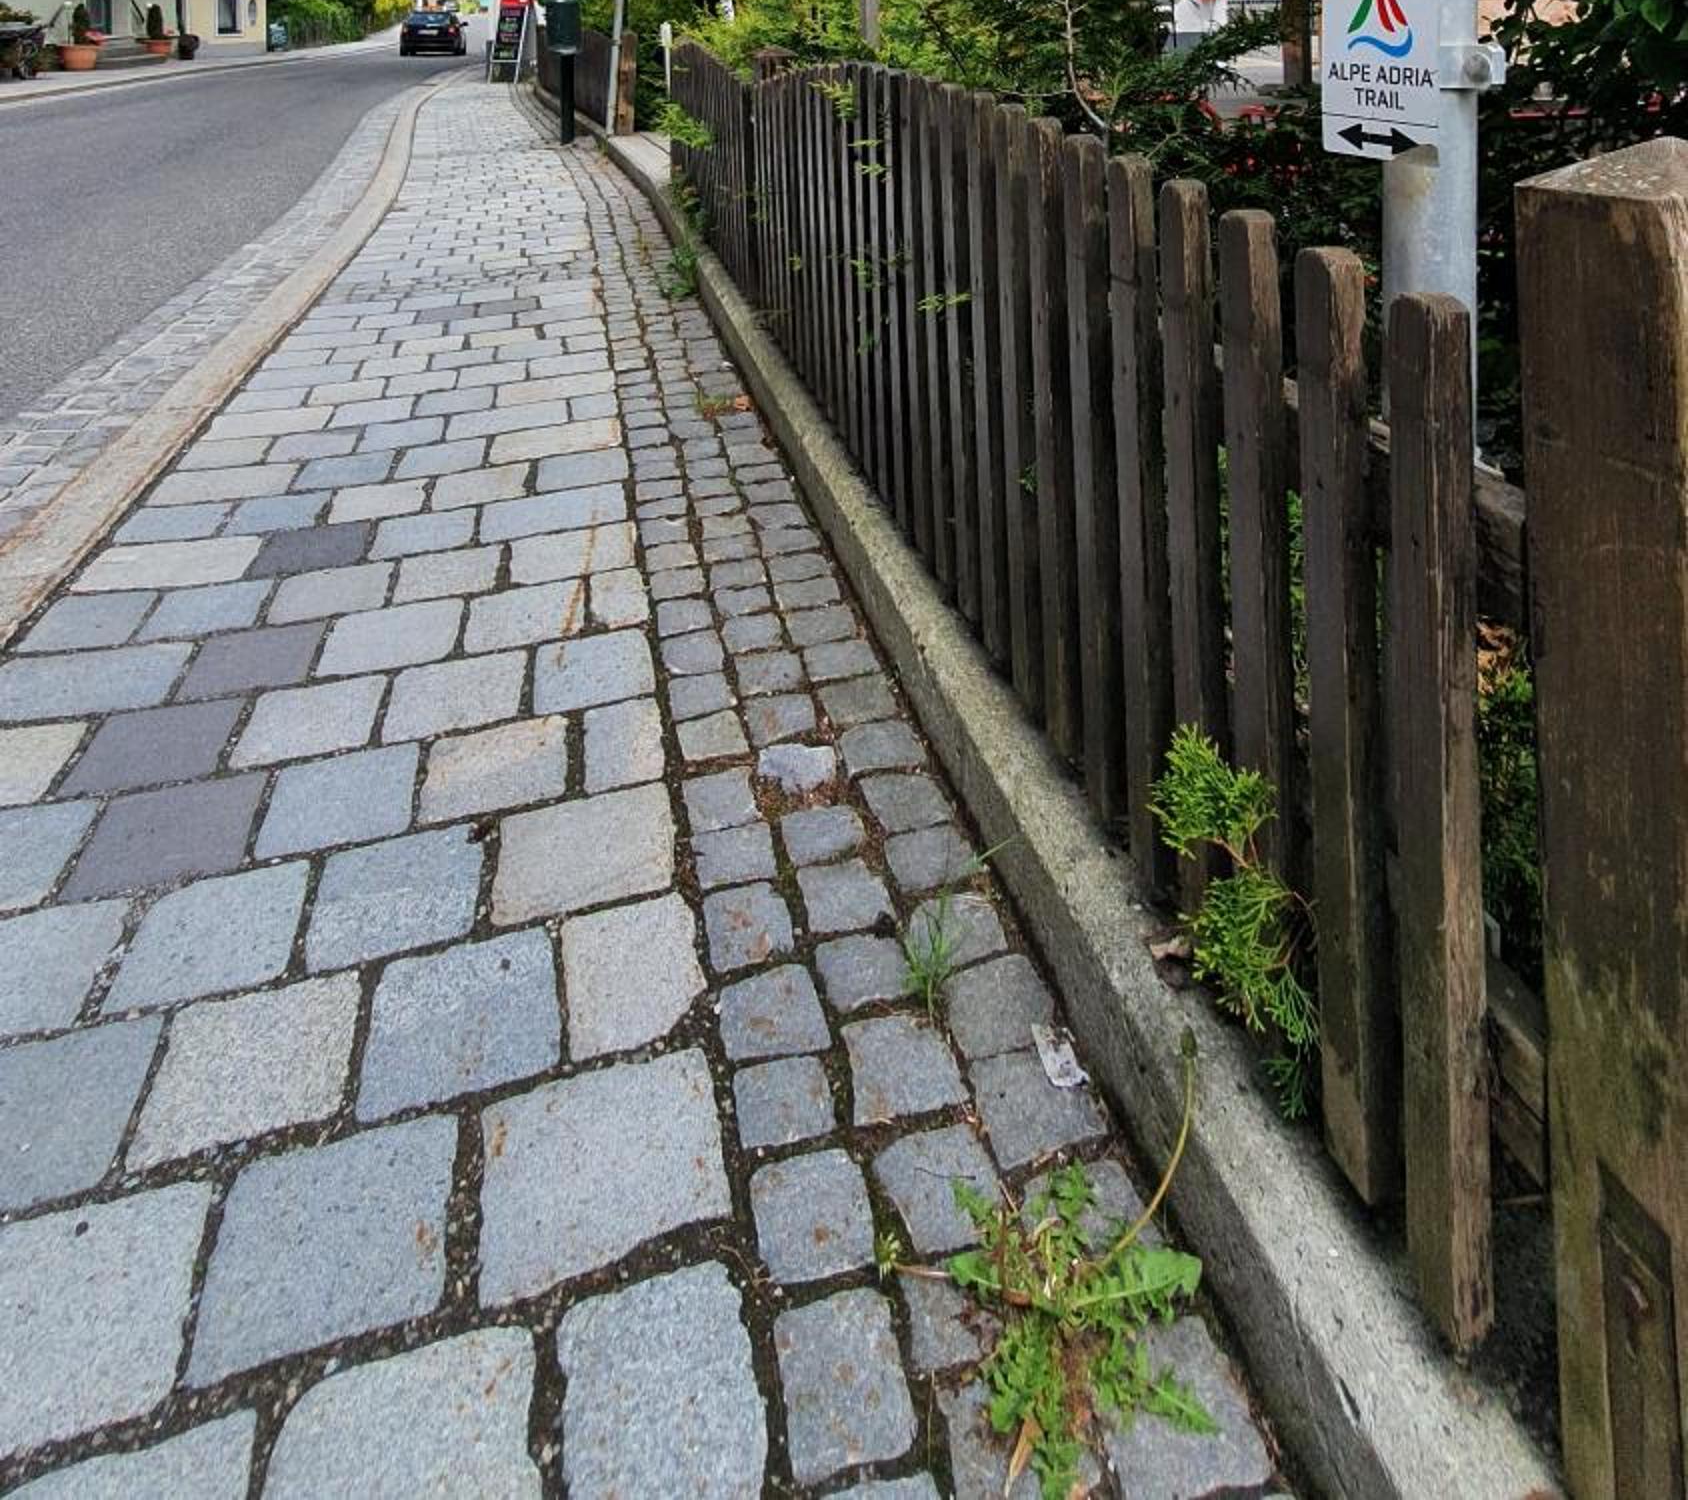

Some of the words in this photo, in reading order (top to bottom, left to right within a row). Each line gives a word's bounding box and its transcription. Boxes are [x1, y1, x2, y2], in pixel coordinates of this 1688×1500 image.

[1328, 62, 1371, 83] ALPE
[1375, 65, 1434, 88] ADRIA
[1353, 87, 1405, 111] TRAIL
